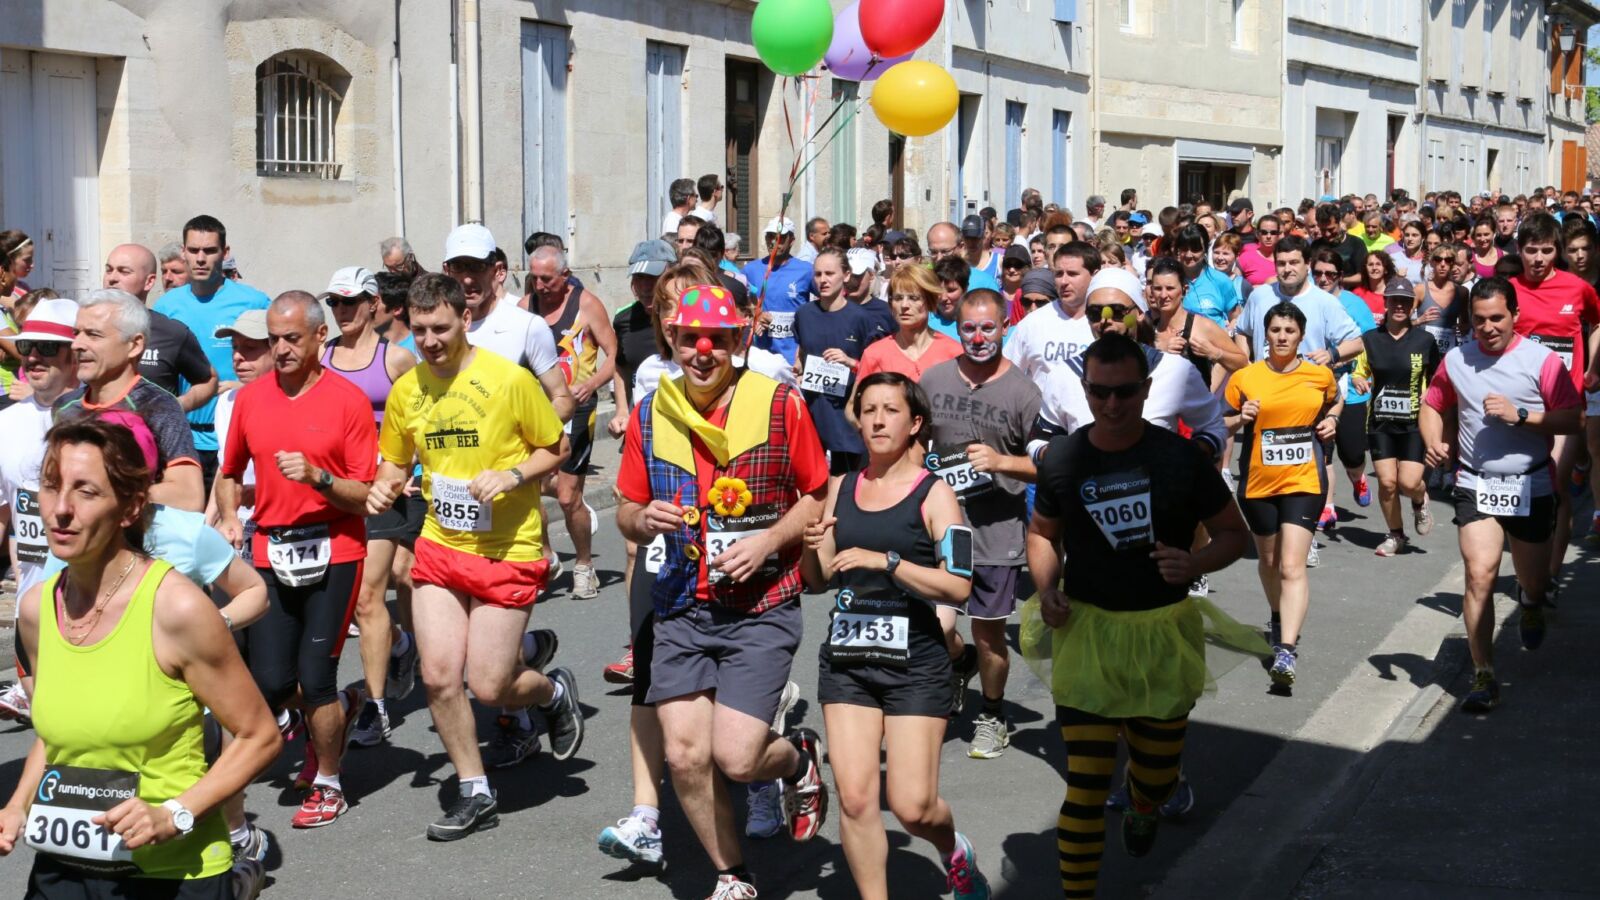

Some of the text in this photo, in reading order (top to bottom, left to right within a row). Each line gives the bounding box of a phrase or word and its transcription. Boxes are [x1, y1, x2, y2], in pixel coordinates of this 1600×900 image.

[770, 323, 792, 334] 294
[804, 371, 840, 388] 2767
[932, 392, 1010, 424] CREEKS
[1376, 400, 1404, 411] 3191
[1265, 447, 1305, 461] 3190
[434, 498, 480, 521] 2855
[1479, 493, 1521, 508] 2950
[272, 544, 318, 565] 3171
[836, 619, 894, 642] 3153
[29, 815, 109, 851] 3061
